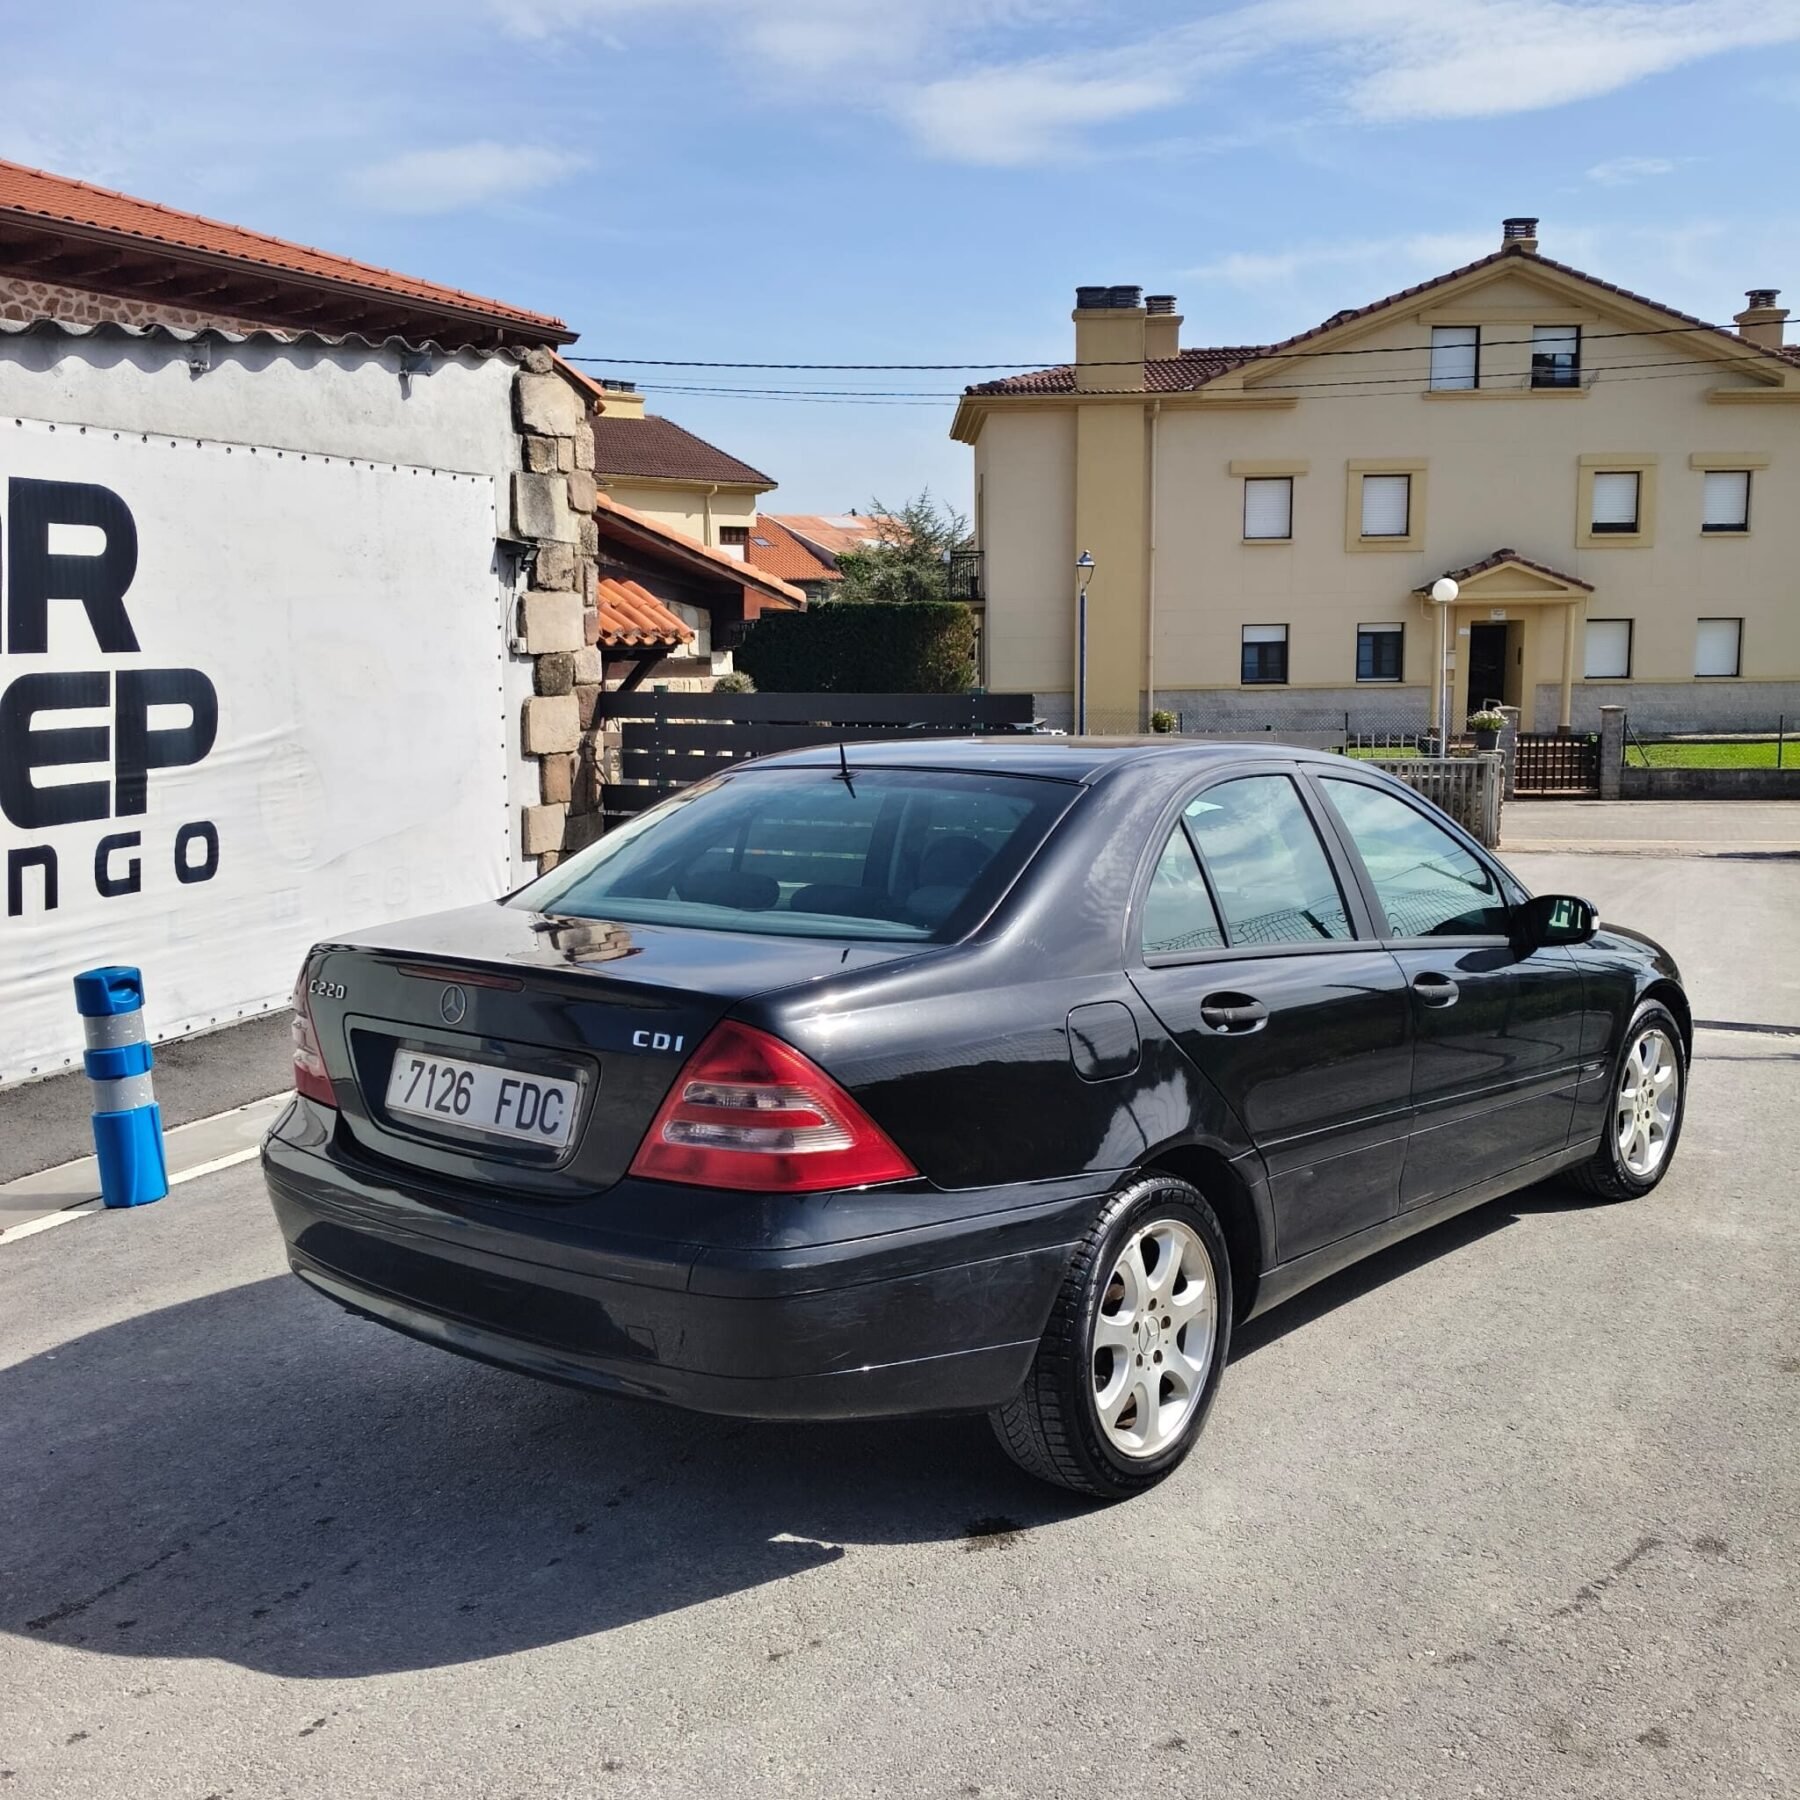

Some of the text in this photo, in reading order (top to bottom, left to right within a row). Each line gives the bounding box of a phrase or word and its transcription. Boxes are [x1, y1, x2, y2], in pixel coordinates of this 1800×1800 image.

[0, 476, 141, 654] R
[0, 668, 219, 829] EP
[404, 1060, 564, 1135] 7126 FDC
[633, 1030, 684, 1051] CDI
